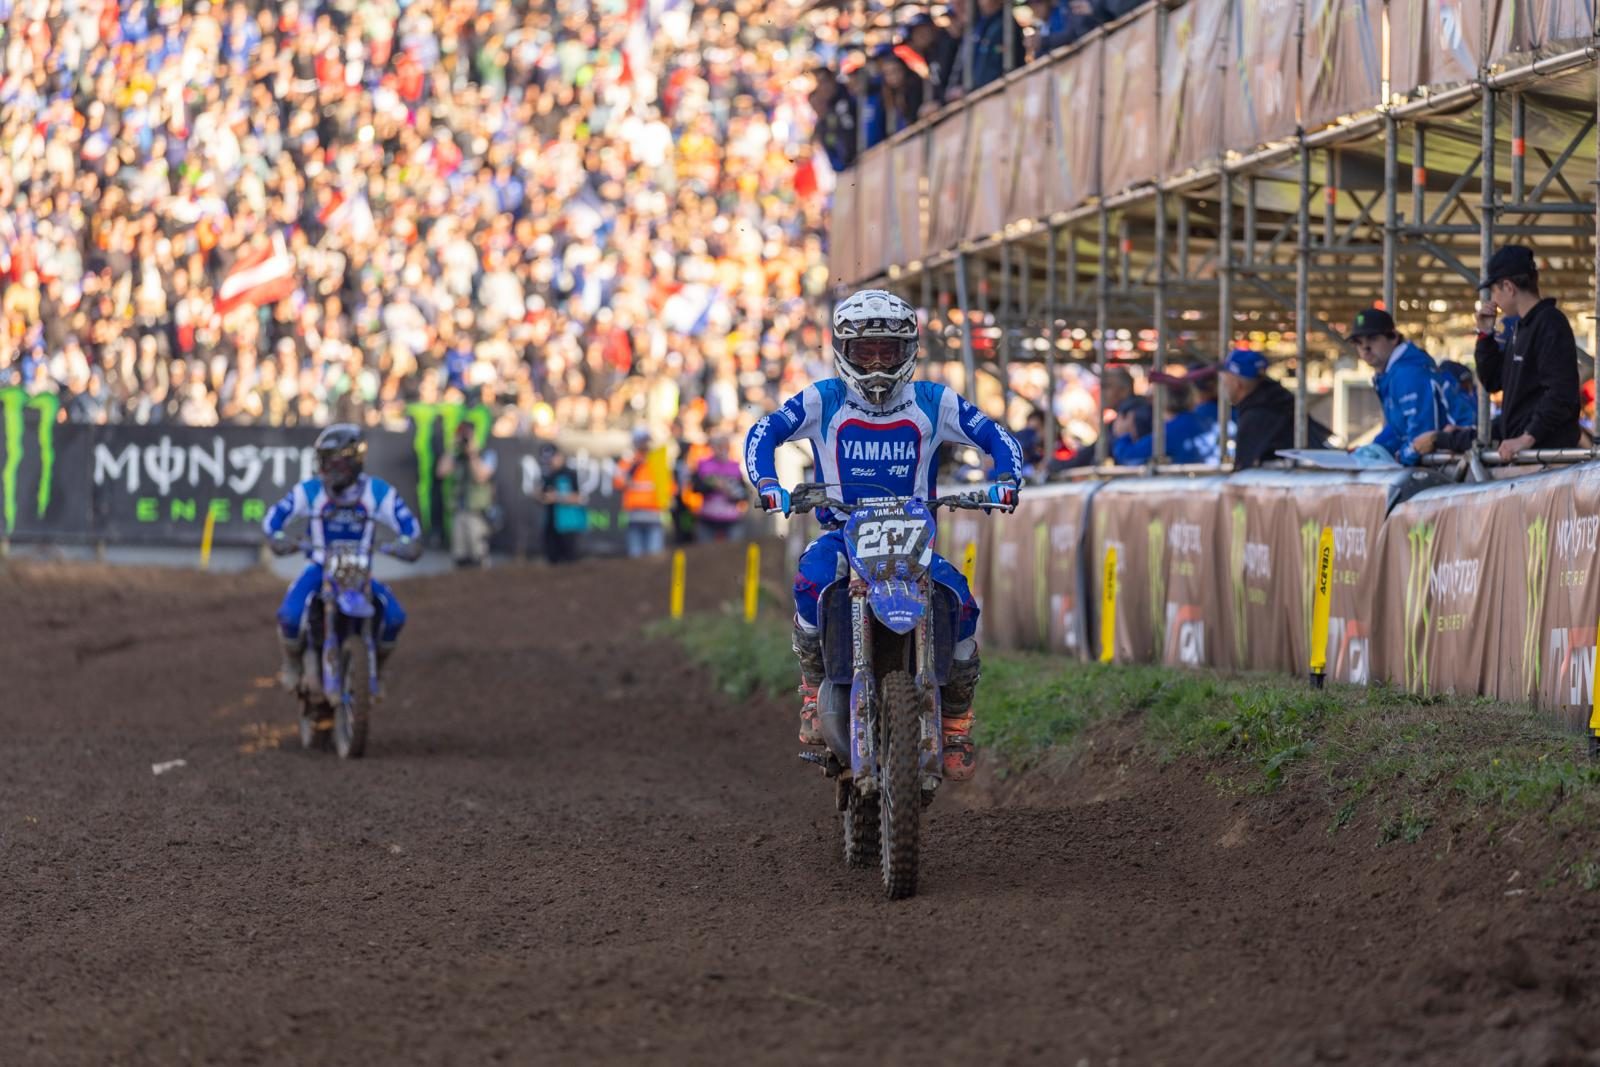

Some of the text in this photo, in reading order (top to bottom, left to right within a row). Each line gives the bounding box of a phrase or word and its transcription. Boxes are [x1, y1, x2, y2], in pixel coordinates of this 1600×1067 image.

[94, 435, 318, 496] MONST
[746, 415, 771, 482] alpinestars
[841, 439, 916, 461] YAMAHA
[136, 498, 266, 523] ENER
[874, 507, 904, 517] YAMAHA
[1320, 546, 1330, 596] ACERBIS
